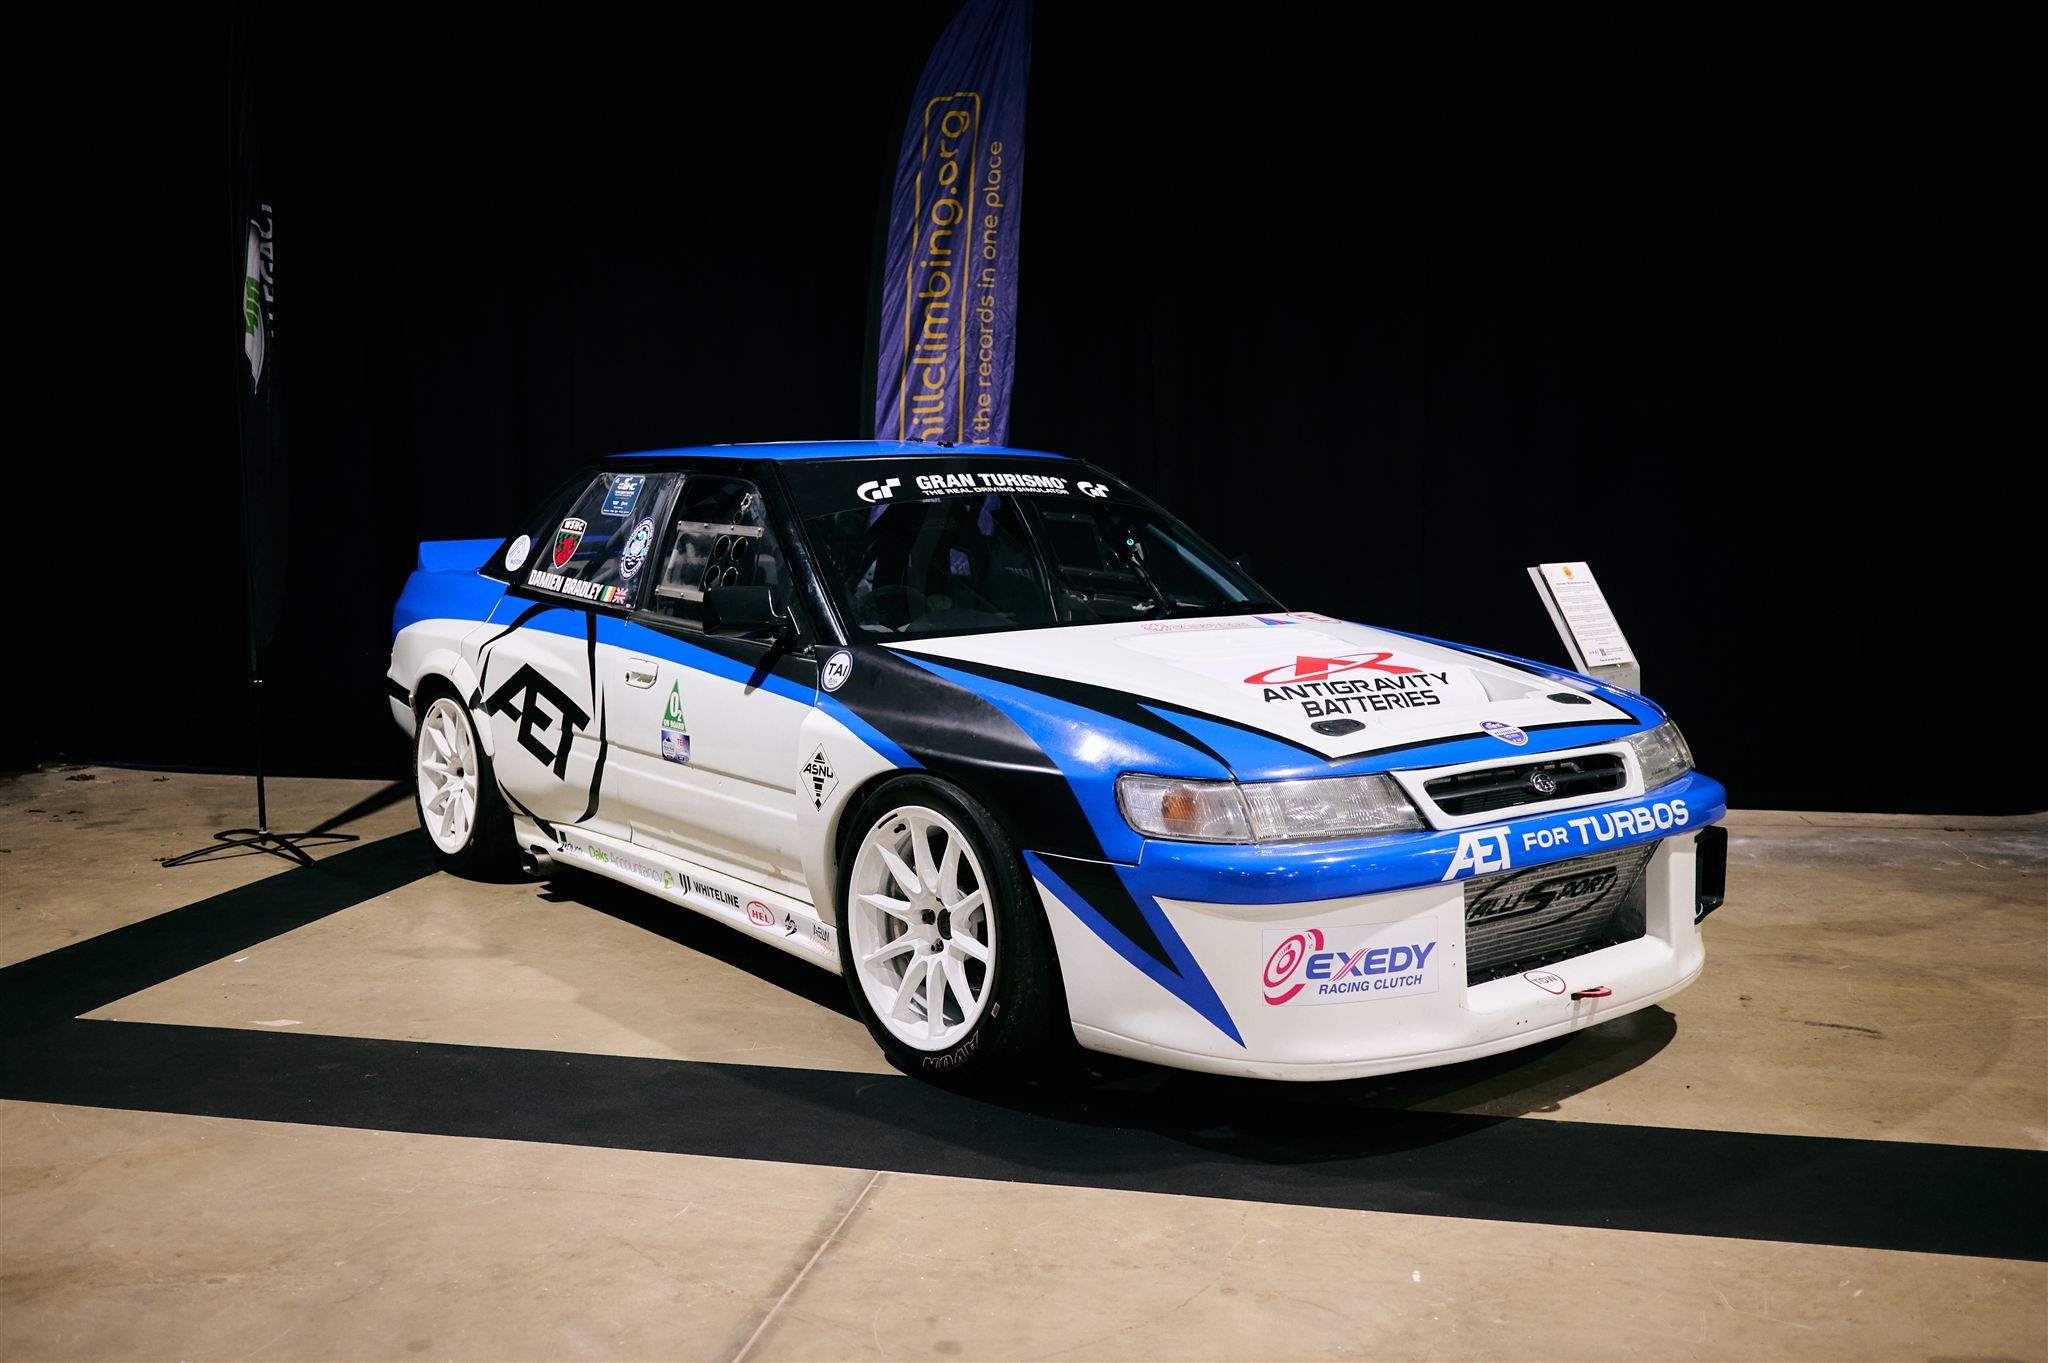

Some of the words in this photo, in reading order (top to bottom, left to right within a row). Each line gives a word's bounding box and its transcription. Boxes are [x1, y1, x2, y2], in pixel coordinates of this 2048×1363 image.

[983, 141, 1004, 208] place
[982, 215, 999, 259] one
[976, 261, 996, 288] in
[973, 295, 995, 387] records
[973, 393, 992, 432] the
[915, 473, 976, 490] GRAN
[977, 473, 1066, 489] TURISMO
[1016, 487, 1070, 495] SIMULATOR
[528, 569, 565, 592] DAMIEN
[561, 577, 604, 600] BRADLEY
[829, 663, 848, 676] TAI
[1263, 671, 1450, 703] ANTIGRAVITY
[1302, 690, 1441, 718] BATTERIES
[485, 663, 591, 781] AET
[1441, 825, 1511, 882] AET
[1522, 827, 1569, 851] FOR
[1568, 800, 1689, 845] TURBOS
[693, 881, 740, 909] WHITELINE
[752, 909, 770, 924] HEL
[1305, 941, 1437, 981] EXEDY
[1319, 981, 1370, 996] RACING
[1374, 974, 1423, 990] CLUTCH
[1532, 973, 1558, 986] TOW
